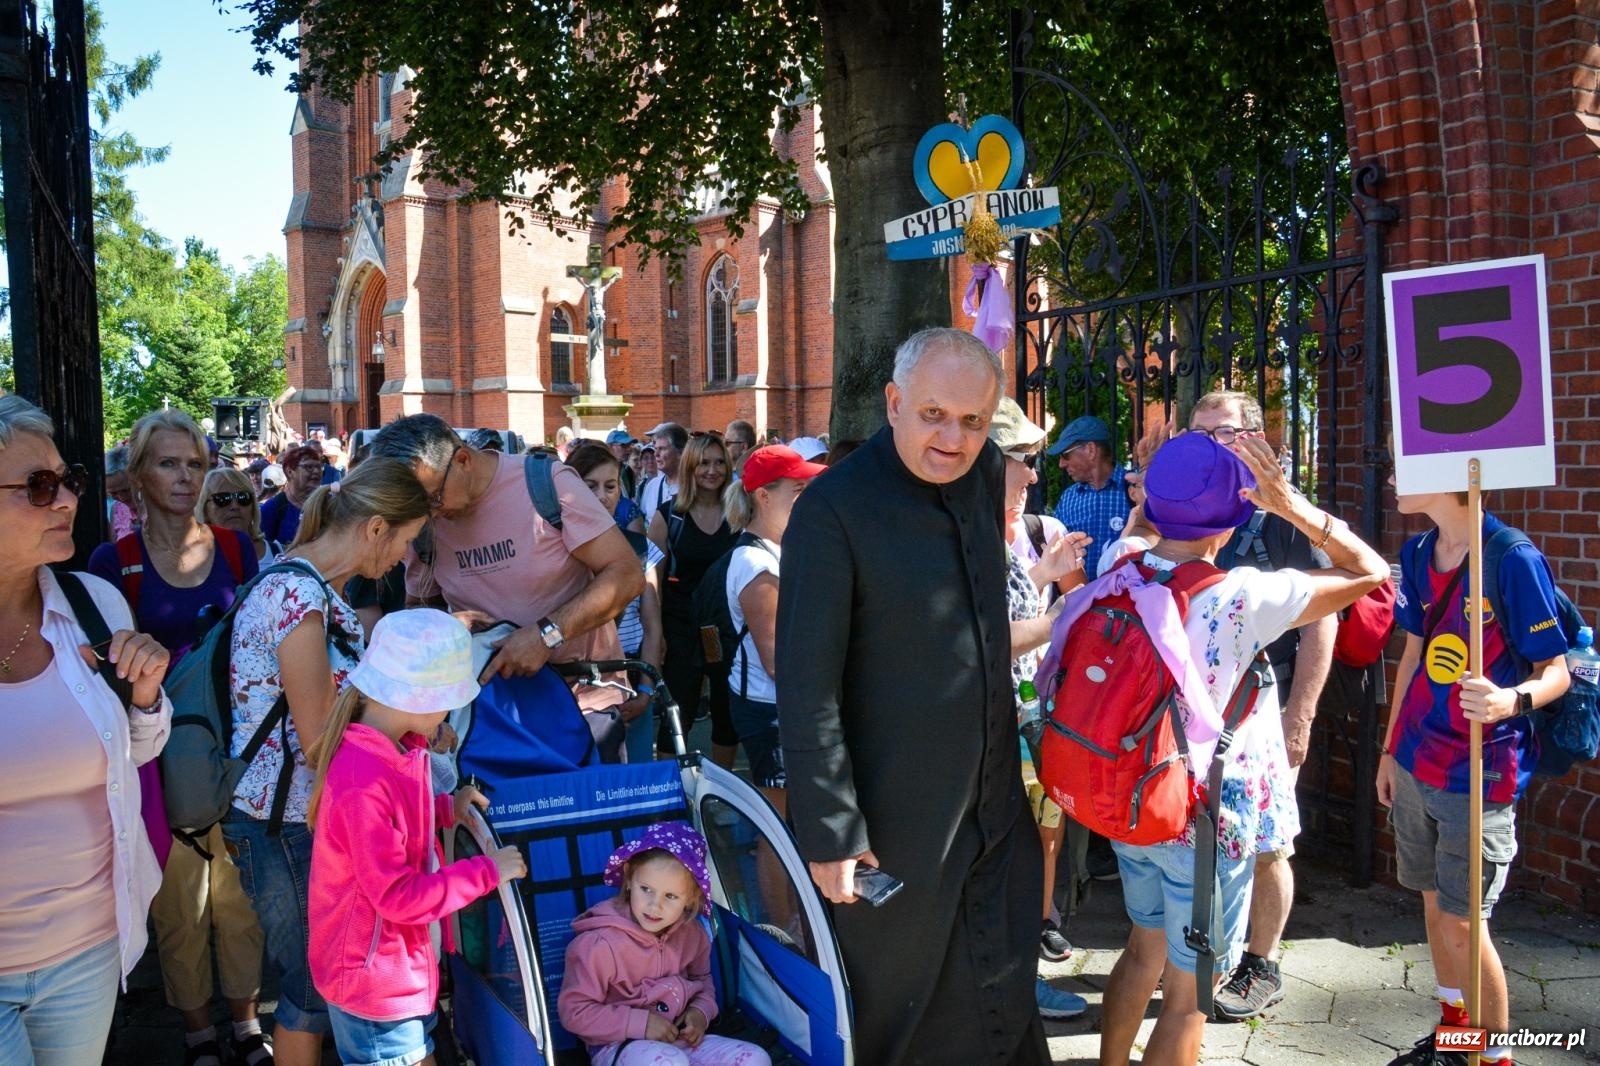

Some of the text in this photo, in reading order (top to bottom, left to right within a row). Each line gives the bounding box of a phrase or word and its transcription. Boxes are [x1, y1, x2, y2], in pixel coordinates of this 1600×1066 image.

[1412, 285, 1522, 434] 5
[455, 539, 516, 569] DYNAMIC
[595, 790, 606, 802] Die
[634, 784, 649, 796] nicht
[495, 804, 506, 815] not
[508, 801, 536, 815] overpass
[537, 798, 550, 810] this
